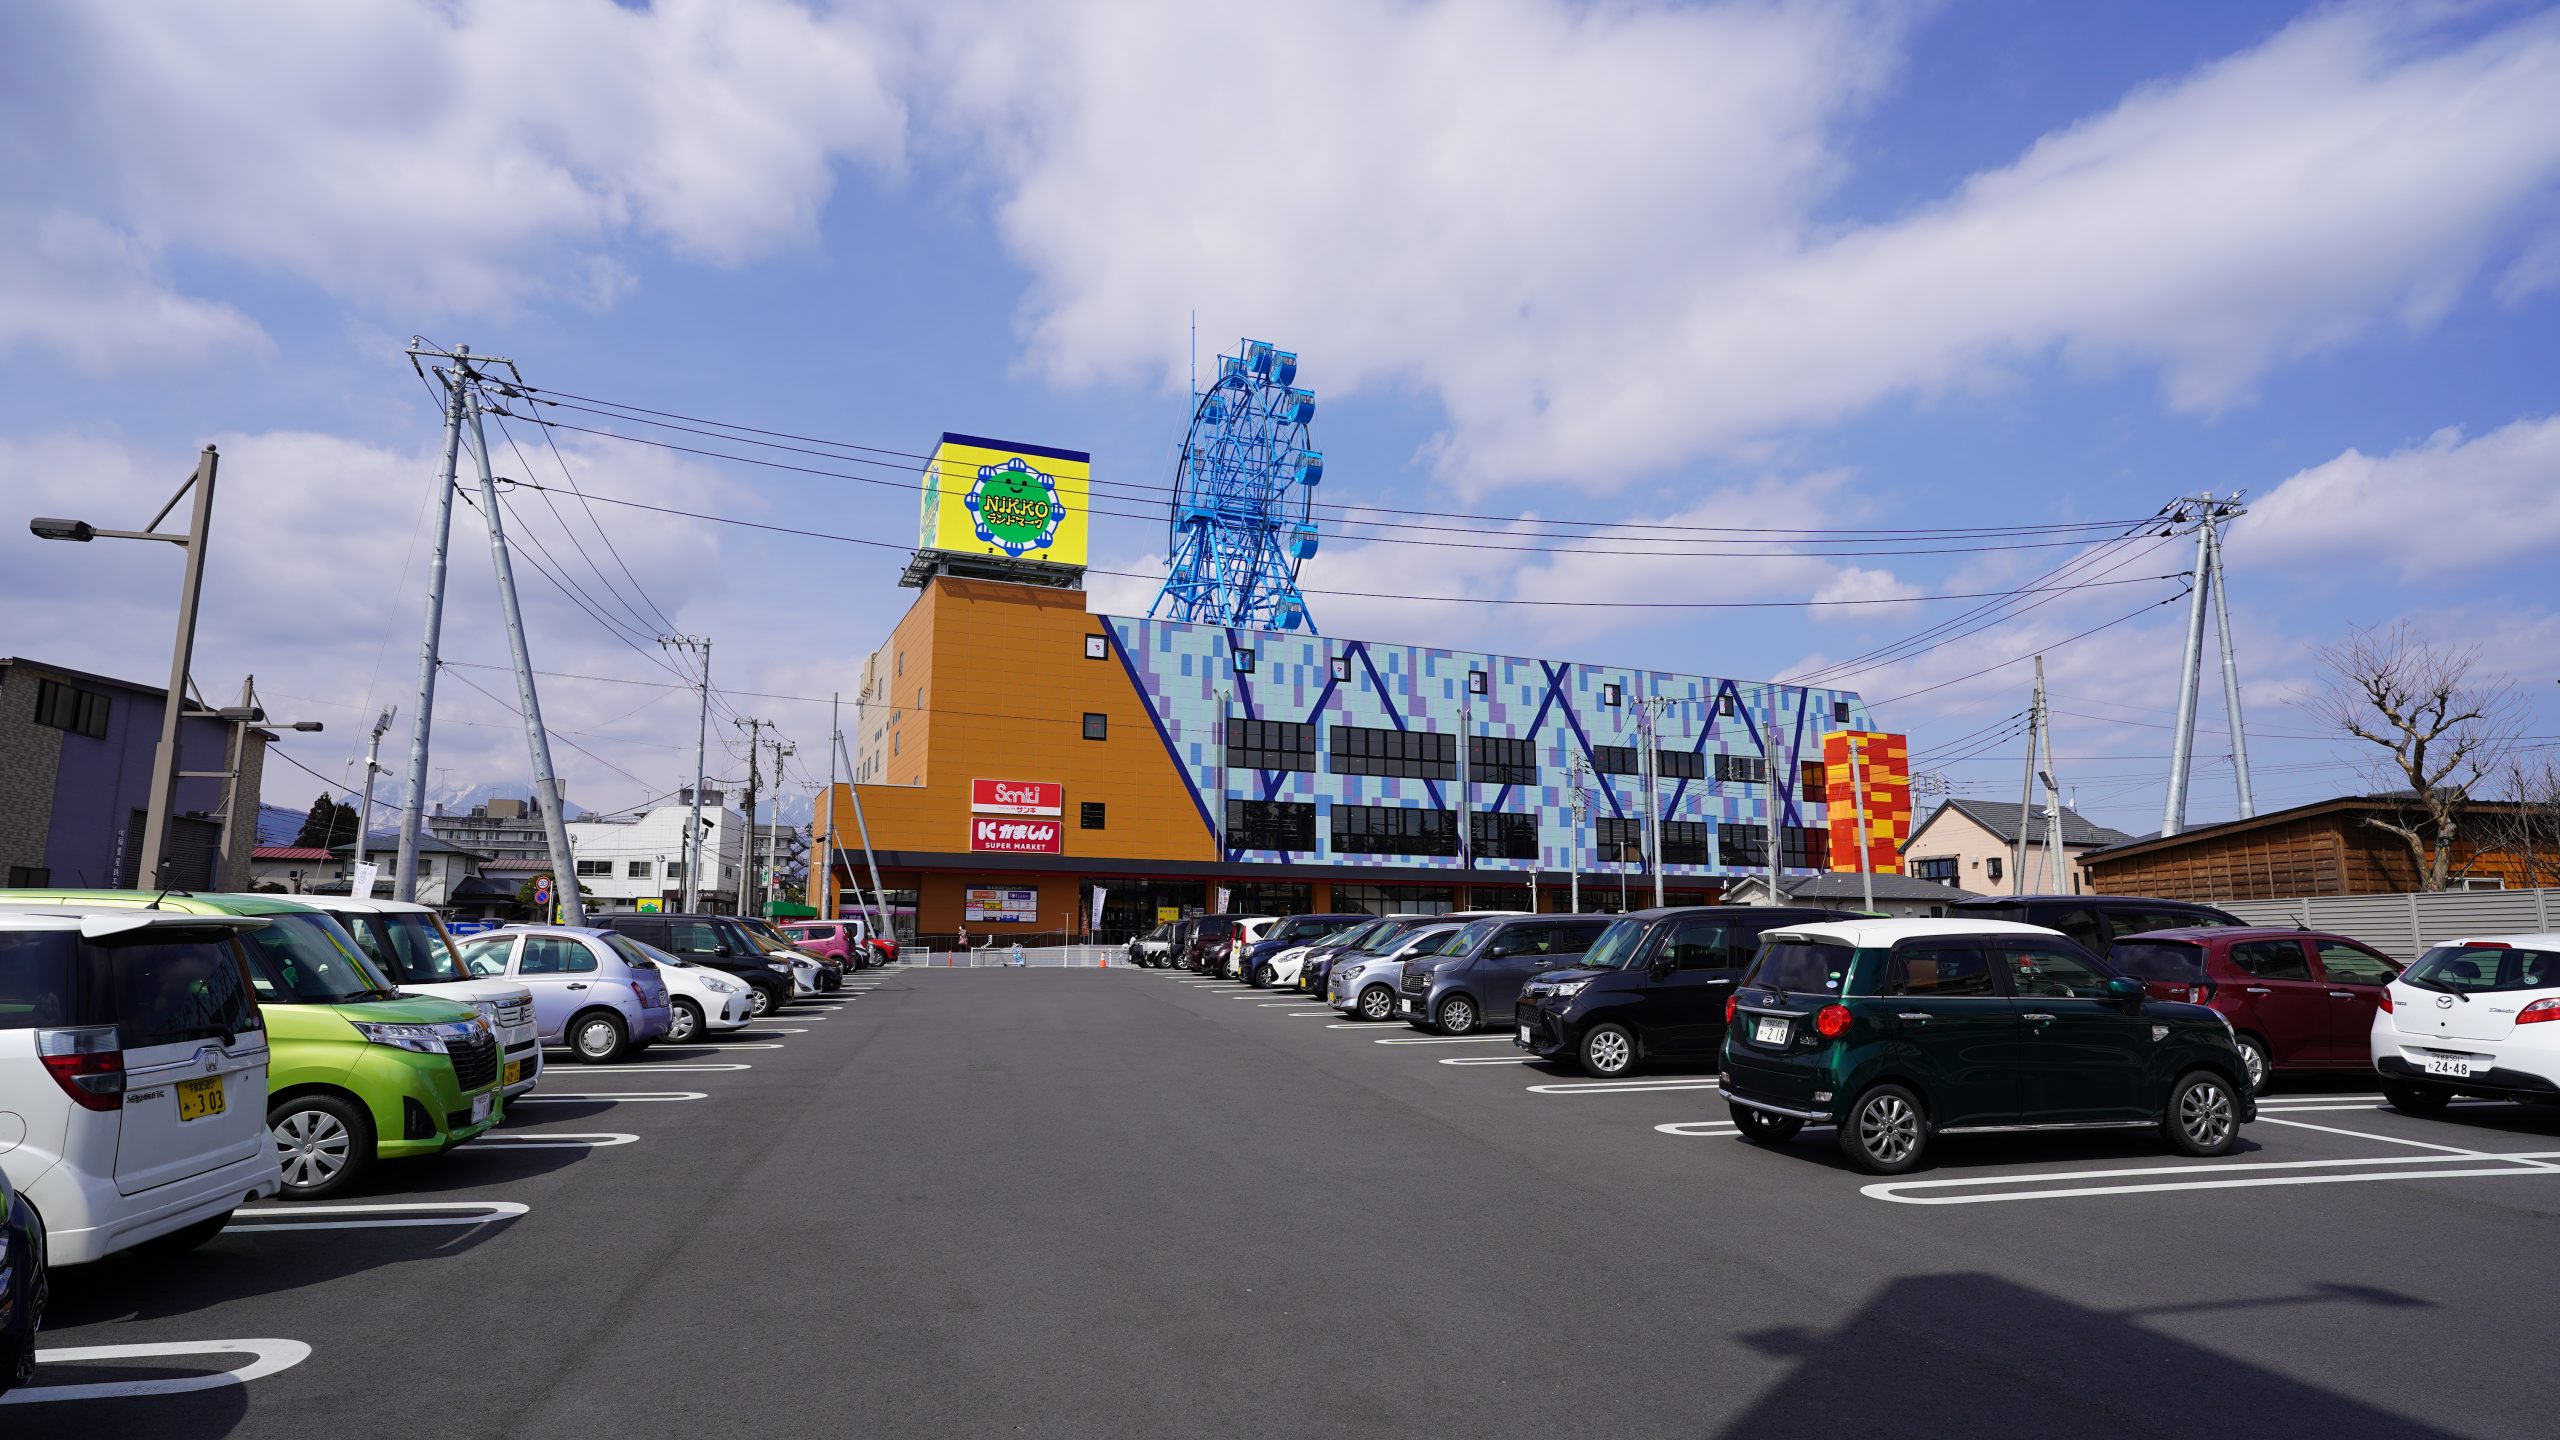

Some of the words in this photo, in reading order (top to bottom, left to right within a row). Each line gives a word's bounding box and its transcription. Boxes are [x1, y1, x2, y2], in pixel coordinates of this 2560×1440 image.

[983, 494, 1049, 518] NIKKO
[986, 512, 1043, 529] ランドマーク
[994, 783, 1040, 804] Sanki
[1016, 806, 1037, 814] サンキ
[998, 823, 1054, 841] かましん
[985, 841, 1012, 850] SUPER
[1013, 843, 1047, 851] MARKET
[2434, 1061, 2468, 1075] 24-48
